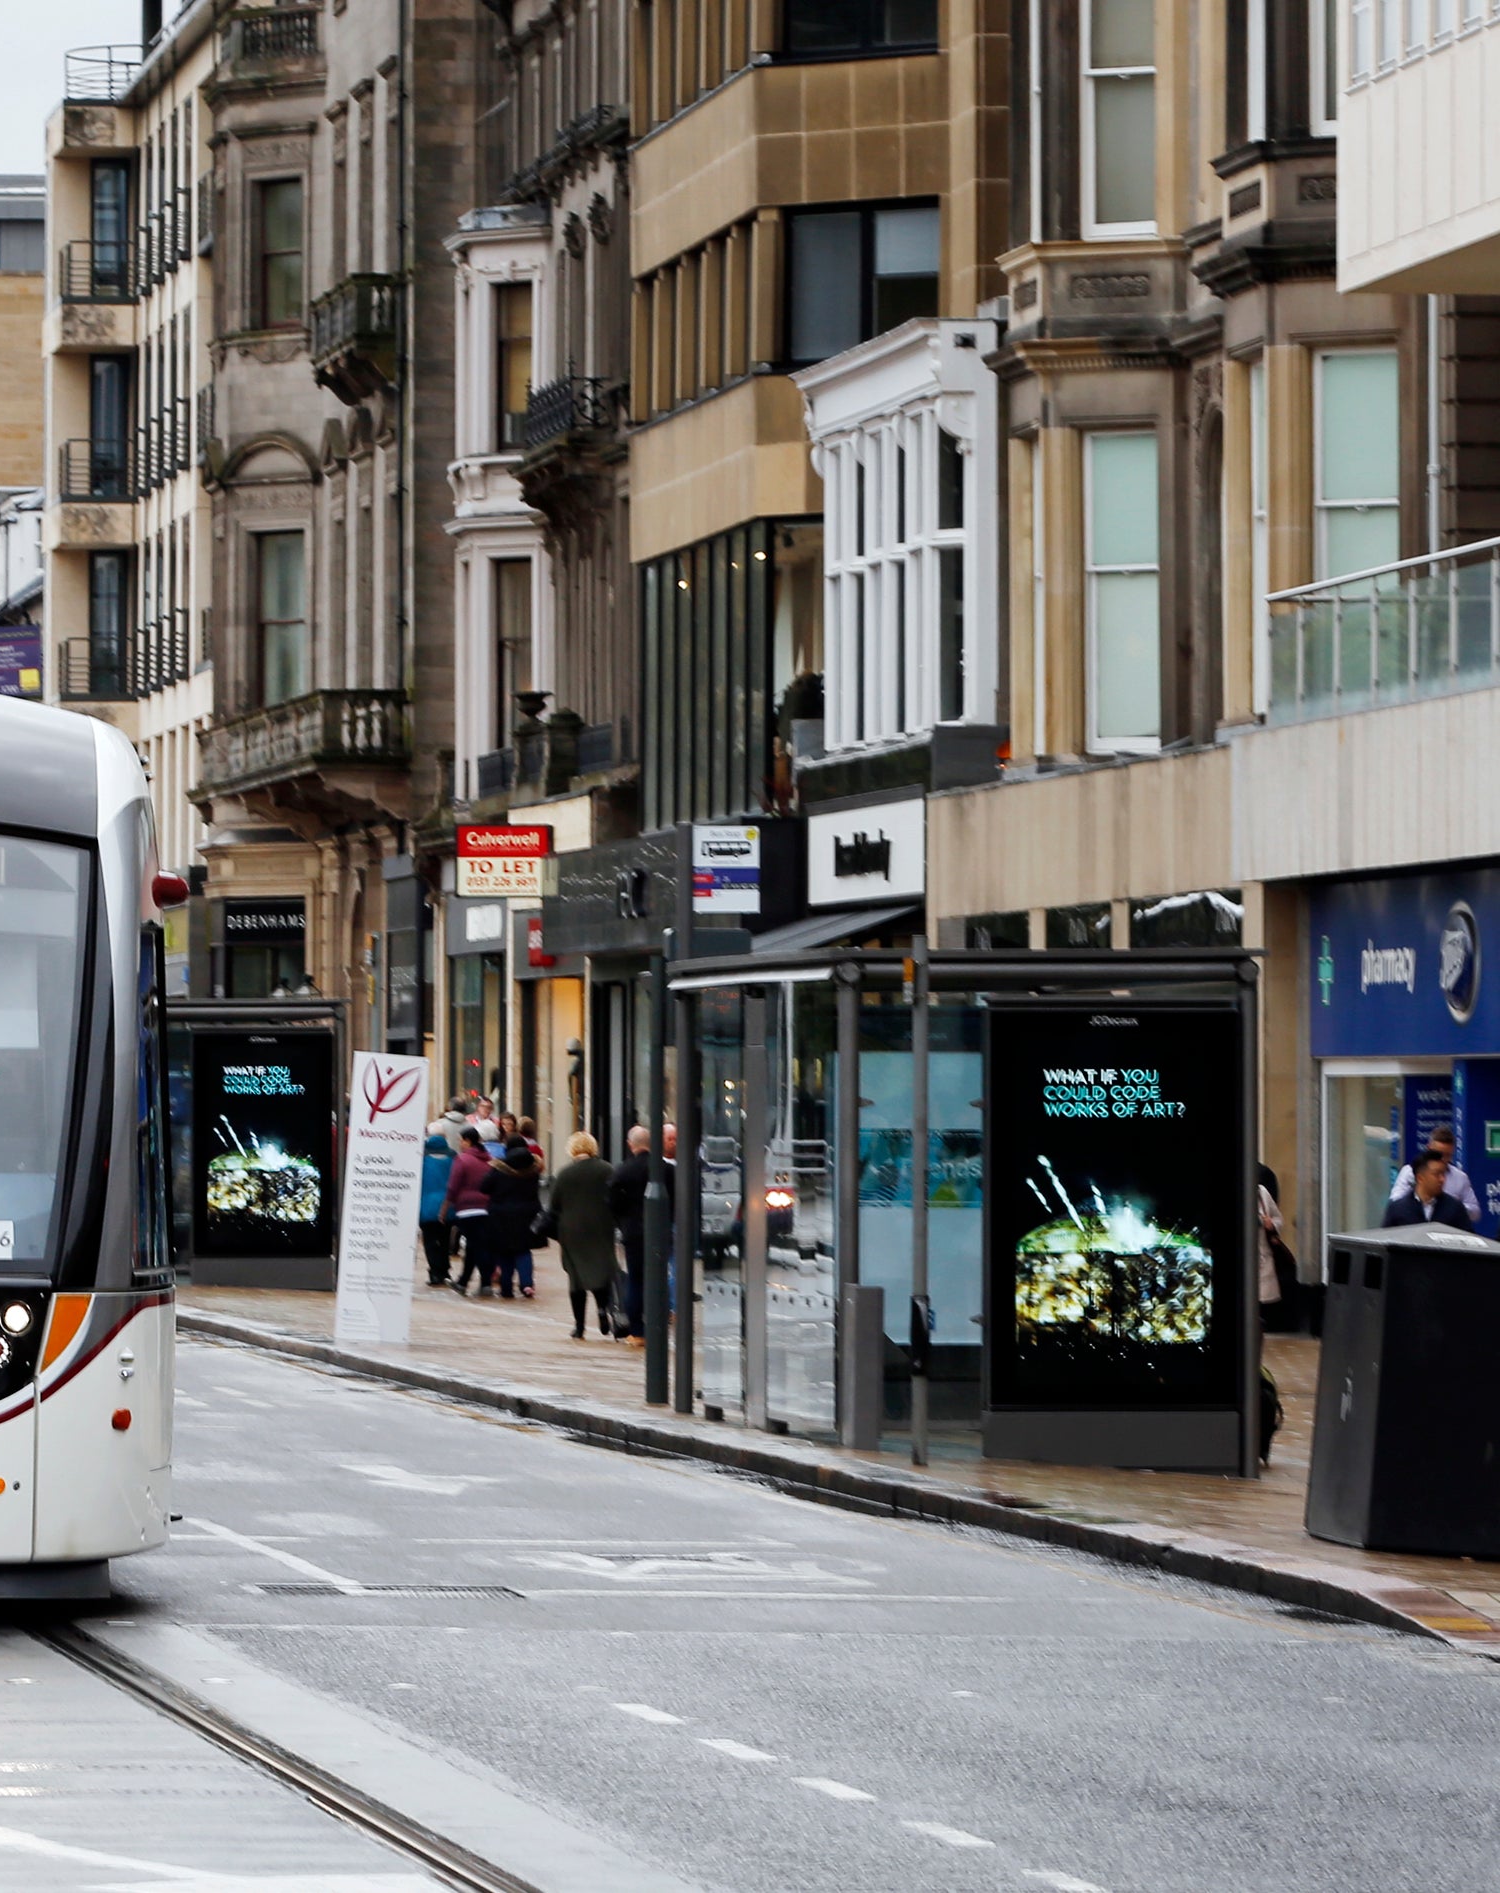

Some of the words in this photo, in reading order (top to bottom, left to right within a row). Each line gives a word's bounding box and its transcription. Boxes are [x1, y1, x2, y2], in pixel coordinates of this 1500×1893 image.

[466, 831, 540, 847] Culverwell
[467, 860, 494, 874] TO
[503, 860, 537, 874] LET
[227, 914, 306, 929] DEBENHAMS
[1361, 939, 1416, 995] pharmacy
[222, 1065, 254, 1076] WHAT
[267, 1065, 290, 1076] YOU
[1043, 1068, 1098, 1085] WHAT
[1100, 1068, 1118, 1085] IF
[1120, 1068, 1160, 1085] YOU
[223, 1075, 260, 1086] COULD
[261, 1075, 291, 1086] CODE
[223, 1085, 261, 1095] WORKS
[1043, 1085, 1107, 1101] COULD
[1110, 1085, 1162, 1101] CODE
[1043, 1101, 1109, 1118] WORKS
[1111, 1101, 1138, 1118] OF
[1141, 1101, 1187, 1118] ART?
